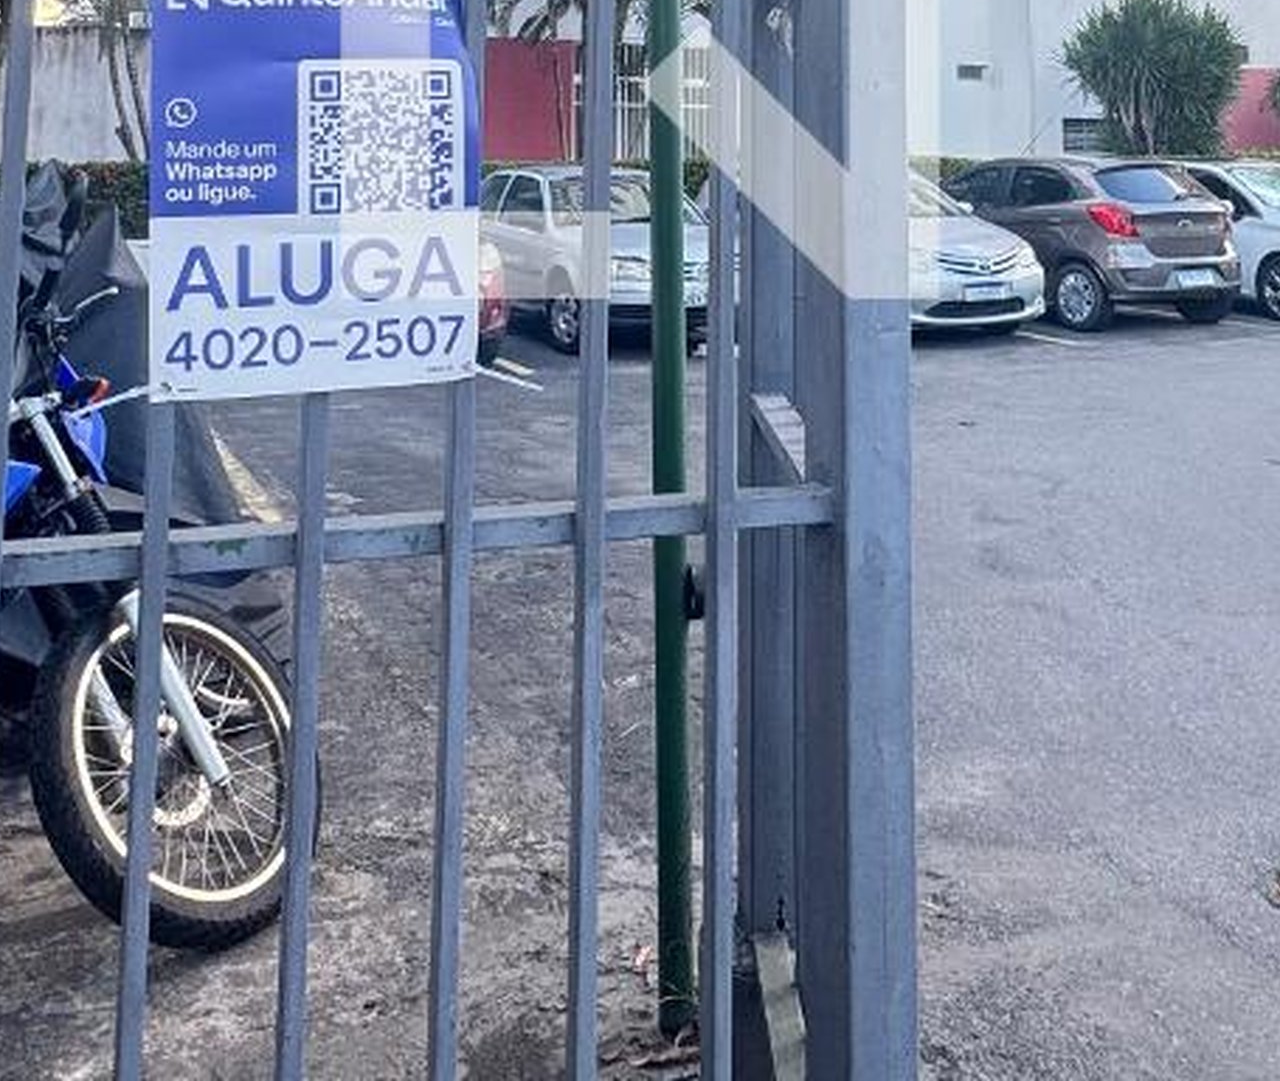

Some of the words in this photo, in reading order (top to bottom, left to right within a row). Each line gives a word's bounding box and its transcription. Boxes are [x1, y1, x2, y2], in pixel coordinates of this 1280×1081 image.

[166, 140, 240, 159] Mande
[243, 143, 277, 158] um
[165, 161, 277, 182] Whatsapp
[165, 187, 193, 201] ou
[198, 183, 257, 205] ligue.
[166, 236, 463, 311] ALUGA
[165, 315, 465, 371] 4020-2507
